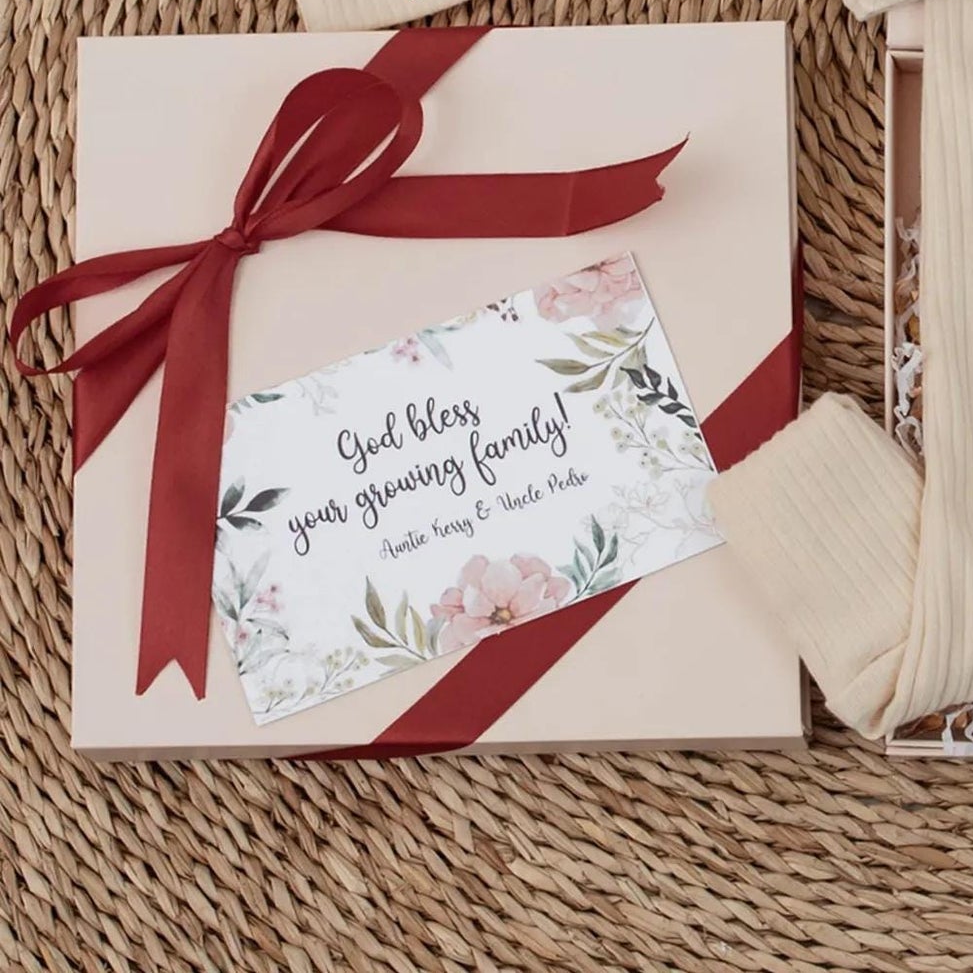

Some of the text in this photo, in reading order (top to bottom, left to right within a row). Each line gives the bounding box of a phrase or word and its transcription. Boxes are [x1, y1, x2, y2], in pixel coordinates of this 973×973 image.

[288, 391, 572, 557] your growing family!
[337, 397, 481, 475] God bless
[379, 468, 590, 560] Auntie Kerry & Uncle Pedro
